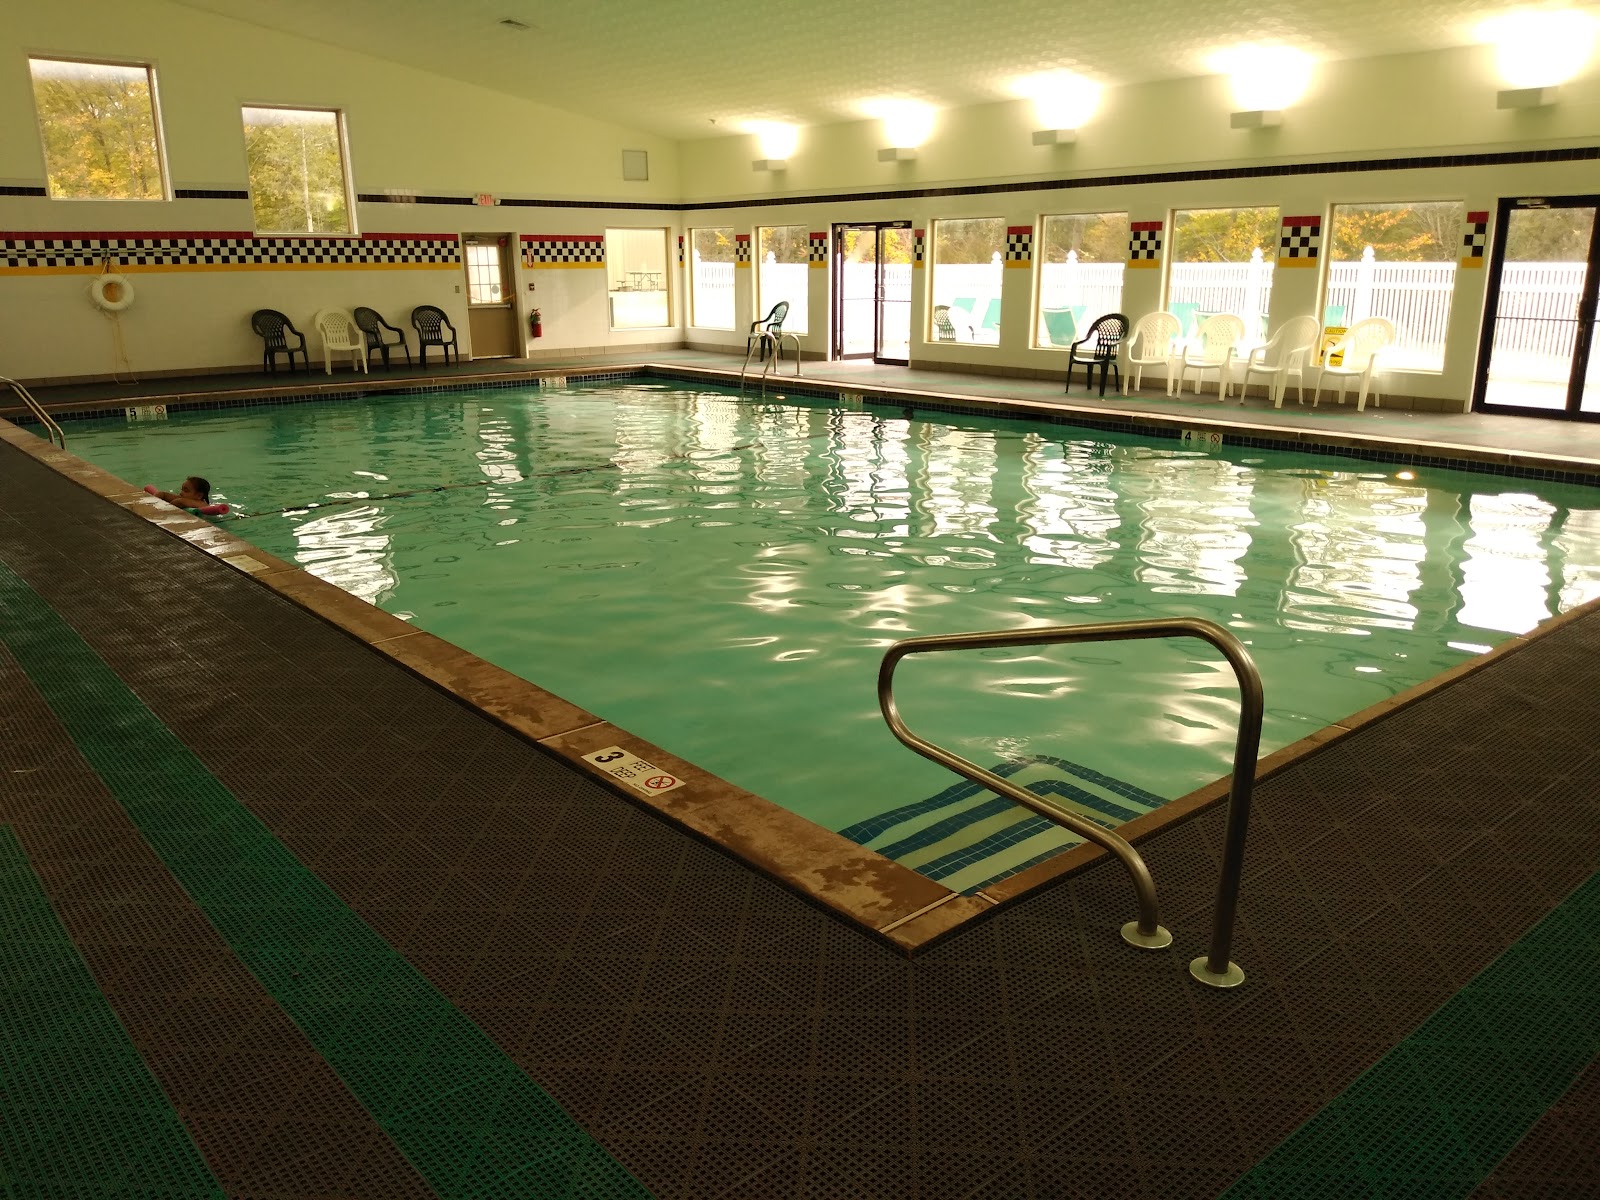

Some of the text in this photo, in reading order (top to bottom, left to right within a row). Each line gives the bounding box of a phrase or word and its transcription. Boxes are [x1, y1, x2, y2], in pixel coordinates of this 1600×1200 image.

[479, 194, 492, 205] EXIT
[129, 407, 137, 417] 5
[1184, 431, 1192, 440] 4
[594, 751, 625, 763] 3
[630, 760, 656, 772] FEET
